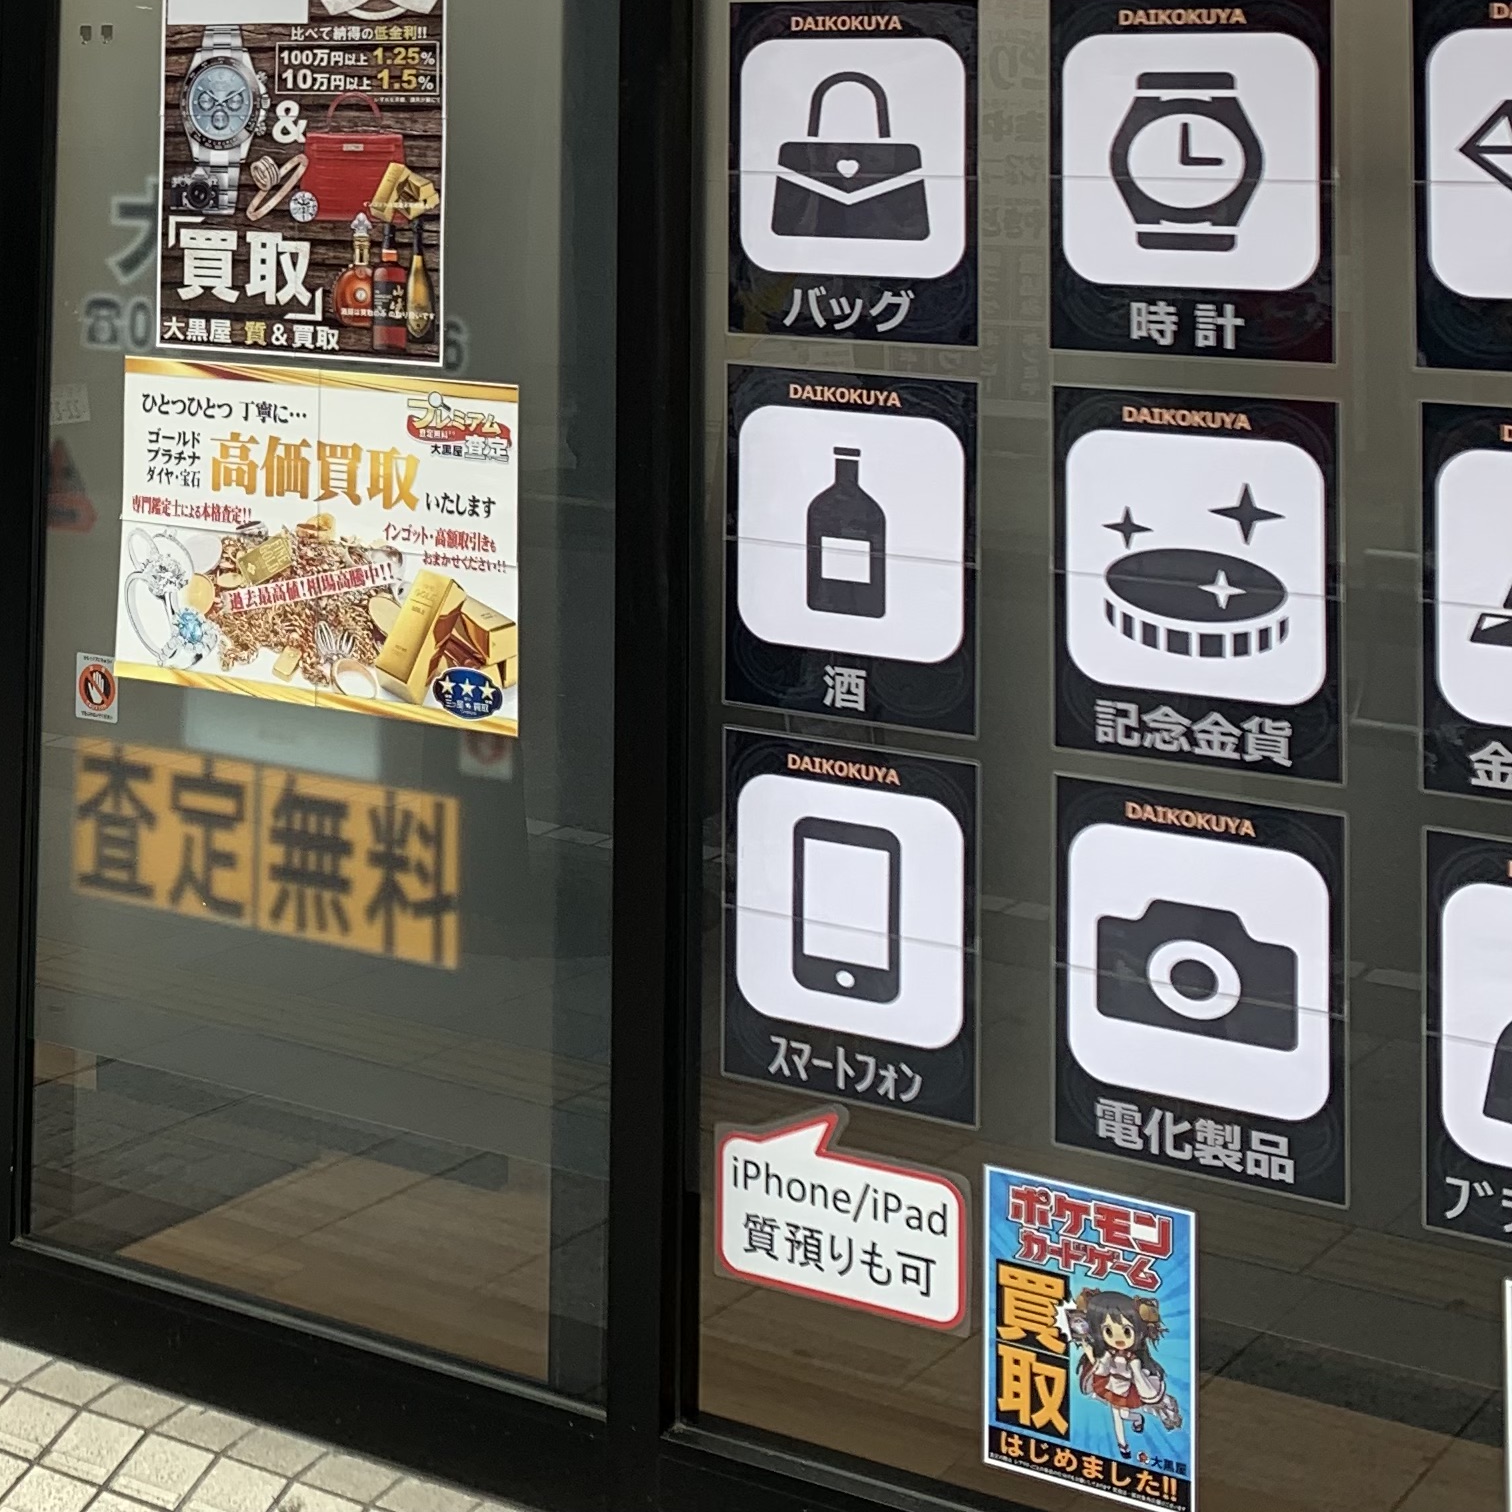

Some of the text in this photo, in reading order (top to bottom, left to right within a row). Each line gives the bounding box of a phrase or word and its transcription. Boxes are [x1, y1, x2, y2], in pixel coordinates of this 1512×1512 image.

[290, 25, 428, 41] 比べて納得の低金利!!
[790, 15, 902, 32] DAIKOKUYA
[1118, 8, 1247, 27] DAIKOKUYA
[372, 46, 436, 66] 1.25%
[376, 68, 435, 91] 1.5%
[272, 99, 308, 144] &
[781, 287, 915, 334] バッグ
[1129, 299, 1246, 350] 時計
[163, 316, 232, 345] 大黒屋
[407, 397, 502, 435] プレミアム
[788, 383, 902, 410] DAIKOKUYA
[1122, 405, 1253, 432] DAIKOKUYA
[147, 428, 201, 449] ゴールド
[147, 447, 201, 467] プラチナ
[147, 466, 201, 489] ダイヤ・宝石
[210, 431, 420, 511] 高価買取
[425, 492, 496, 519] いたします
[822, 664, 867, 714] 酒
[1093, 699, 1294, 769] 記念金貨
[786, 752, 901, 788] DAIKOKUYA
[1124, 800, 1257, 839] DAIKOKUYA
[78, 745, 457, 967] 査定無料
[767, 1034, 924, 1106] スマートフォン
[1094, 1096, 1296, 1186] 電化製品
[732, 1156, 948, 1238] iPhone/iPad
[1008, 1184, 1174, 1259] ポケモン
[742, 1212, 937, 1298] 質預りも可
[1015, 1228, 1162, 1293] カードゲーム
[996, 1264, 1070, 1435] 買取
[1000, 1430, 1179, 1502] はじめました!!
[1151, 1455, 1188, 1476] 大黒屋
